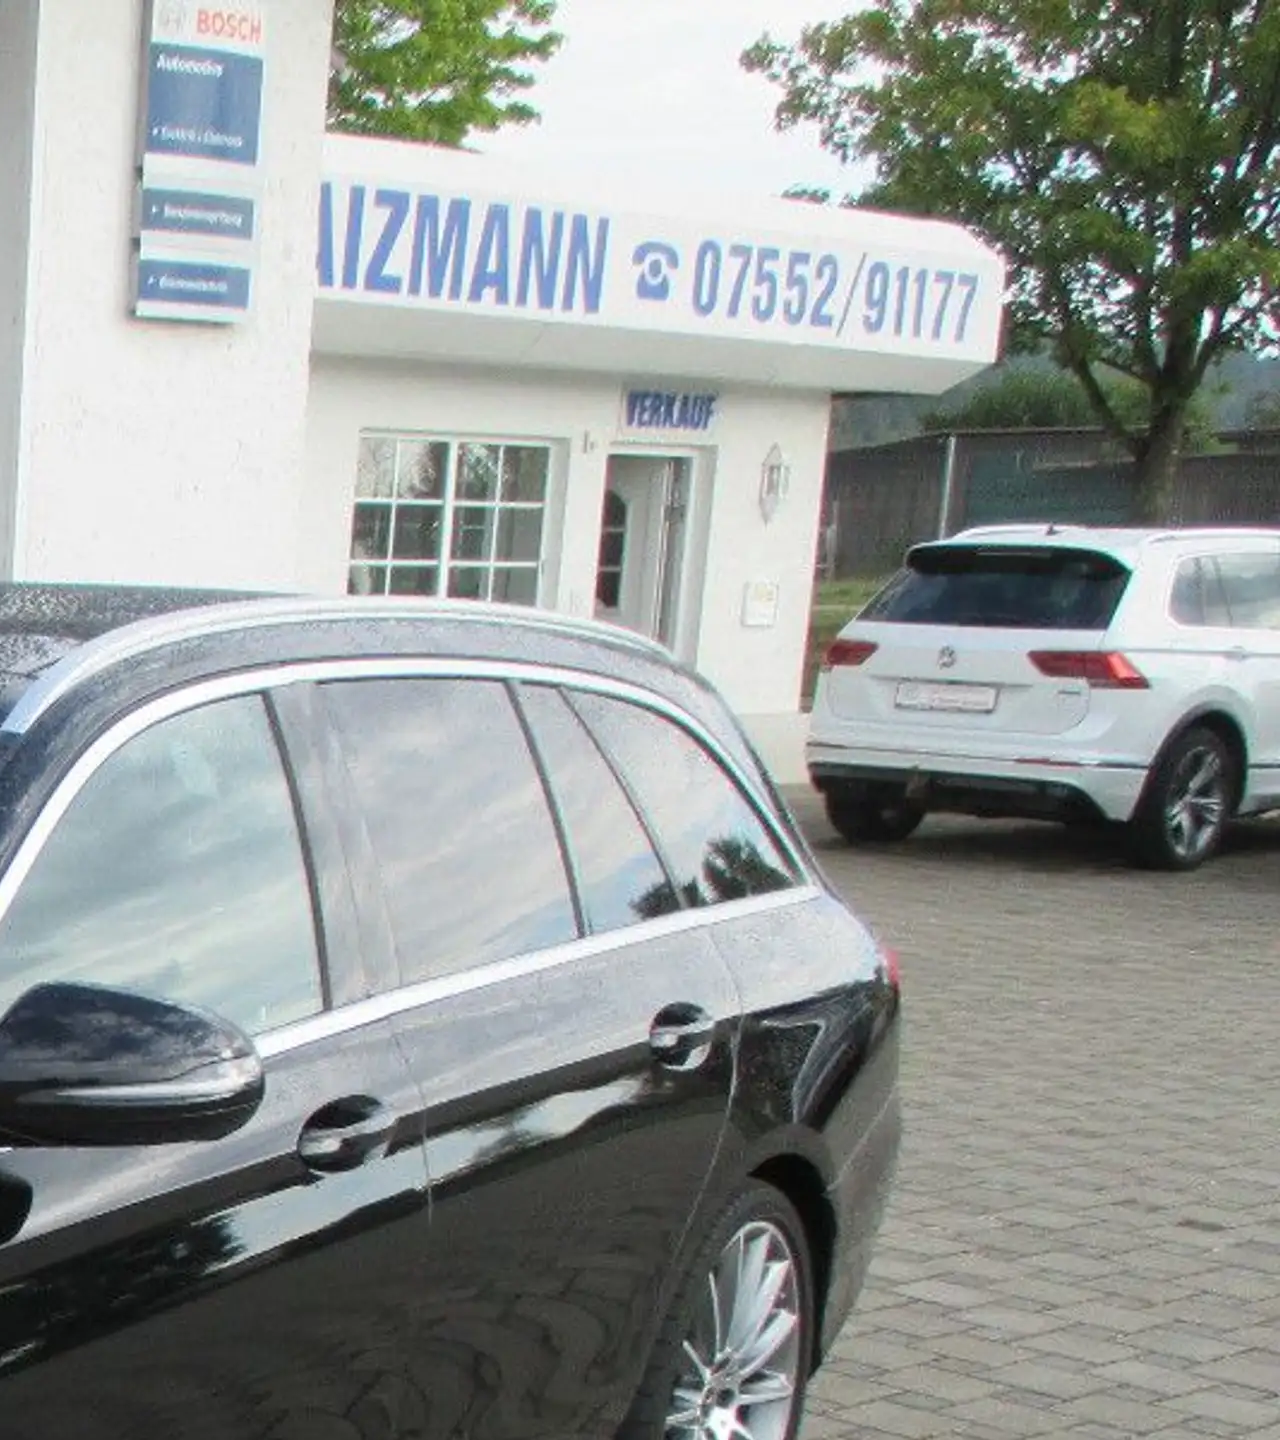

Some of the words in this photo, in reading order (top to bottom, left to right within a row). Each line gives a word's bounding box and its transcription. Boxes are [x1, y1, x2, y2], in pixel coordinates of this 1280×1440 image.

[196, 9, 262, 43] BOSCH
[692, 238, 979, 342] 07552/91177
[626, 391, 717, 430] VERKAUF
